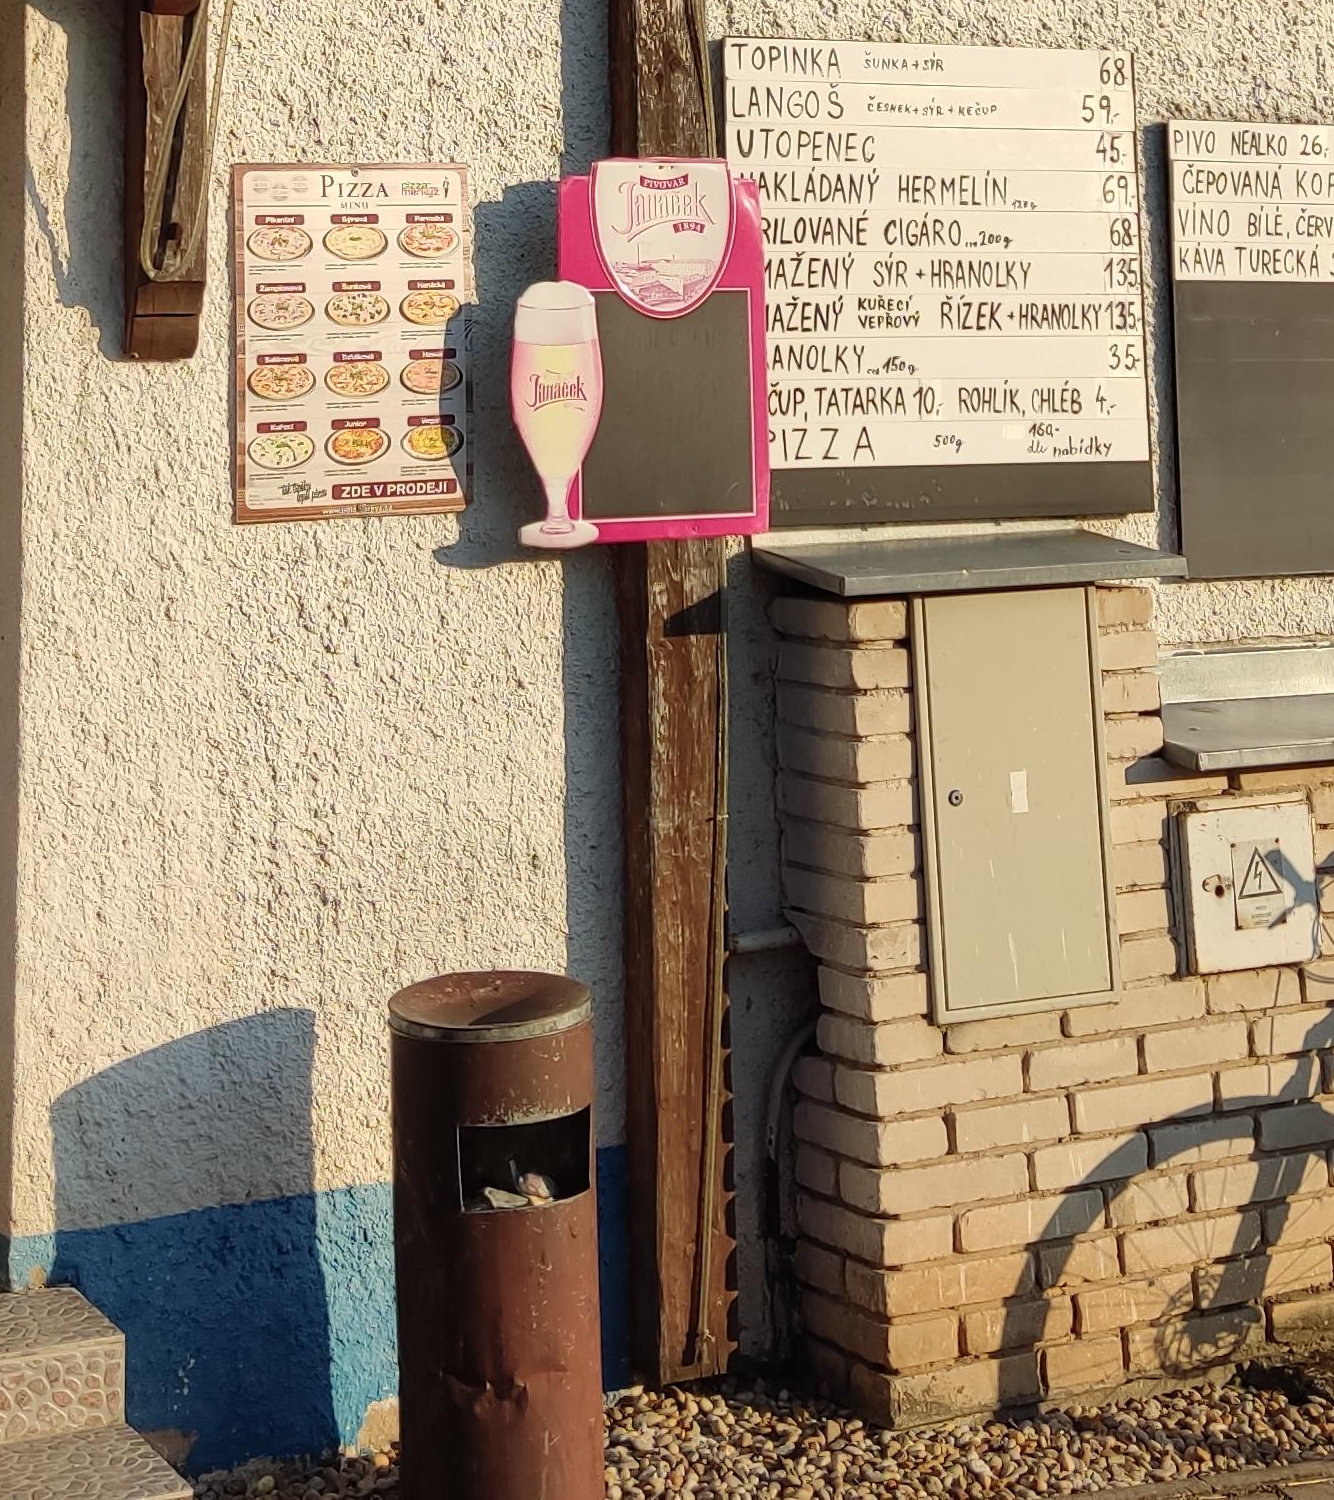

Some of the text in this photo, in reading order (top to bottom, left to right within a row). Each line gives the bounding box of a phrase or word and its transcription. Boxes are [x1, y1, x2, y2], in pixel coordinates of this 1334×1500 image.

[731, 43, 842, 79] TOPINKA
[863, 51, 908, 71] ŠUNKA
[922, 51, 945, 72] SÝR
[731, 83, 845, 120] LANGOŠ
[921, 96, 944, 116] SÝR
[736, 128, 876, 163] UTOPENEC
[1173, 129, 1216, 155] PIVO
[1231, 133, 1288, 157] NEALKO
[643, 176, 685, 190] PIVOVAR
[739, 166, 880, 206] AKLÁDANÝ
[897, 169, 1008, 207] HERMELÍN
[1182, 163, 1283, 200] ČEPOVANÁ
[761, 209, 868, 247] RILOVANÉ
[883, 213, 963, 248] CIGÁRO
[1178, 204, 1230, 238] VÍNO
[764, 251, 855, 290] AŽENÝ
[872, 252, 908, 290] SÝR
[930, 258, 1032, 290] HRANOLKY
[1178, 241, 1226, 275] KÁVA
[1234, 243, 1320, 278] TURECKÁ
[765, 296, 845, 333] AŽENÝ
[857, 294, 913, 312] KUŘECÍ
[939, 294, 1003, 331] ŘÍZEK
[1018, 299, 1102, 333] HRANOLKY
[858, 311, 921, 330] VEPŘOVÝ
[767, 343, 866, 375] ANOLKY
[815, 386, 907, 417] TATARKA
[1031, 379, 1083, 416] CHLÉB
[344, 419, 367, 428] Junior
[341, 484, 370, 498] ZDE
[374, 483, 386, 497] V
[386, 481, 448, 496] PRODEJI
